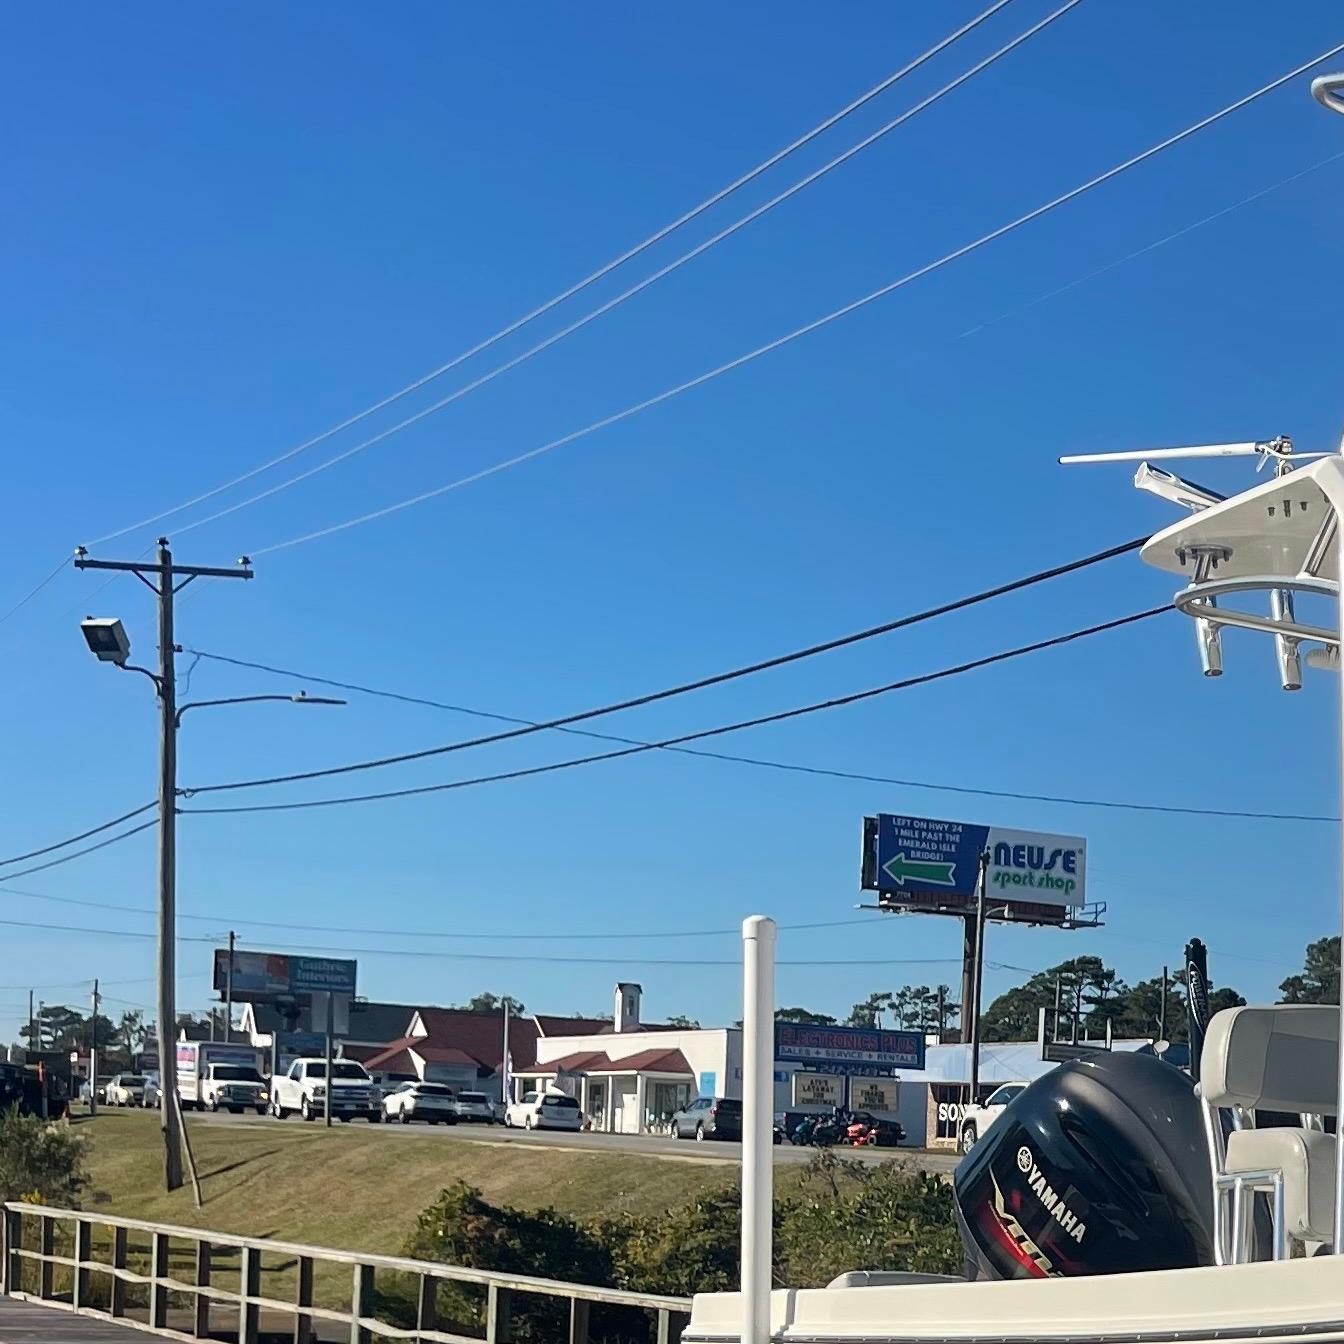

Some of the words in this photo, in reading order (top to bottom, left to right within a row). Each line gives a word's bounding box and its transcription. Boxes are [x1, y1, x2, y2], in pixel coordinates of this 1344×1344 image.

[892, 817, 911, 827] LEFT
[913, 820, 927, 830] ON
[928, 822, 949, 831] HWY
[921, 831, 943, 841] PAST
[994, 842, 1076, 874] NEUSE
[992, 870, 1036, 890] sport
[1036, 871, 1076, 896] shop
[780, 1027, 879, 1051] ELECTRONICS
[880, 1034, 917, 1055] PLUS
[826, 1050, 864, 1059] SERVICE
[939, 1102, 966, 1121] SON
[1028, 1163, 1086, 1244] YAMAHA
